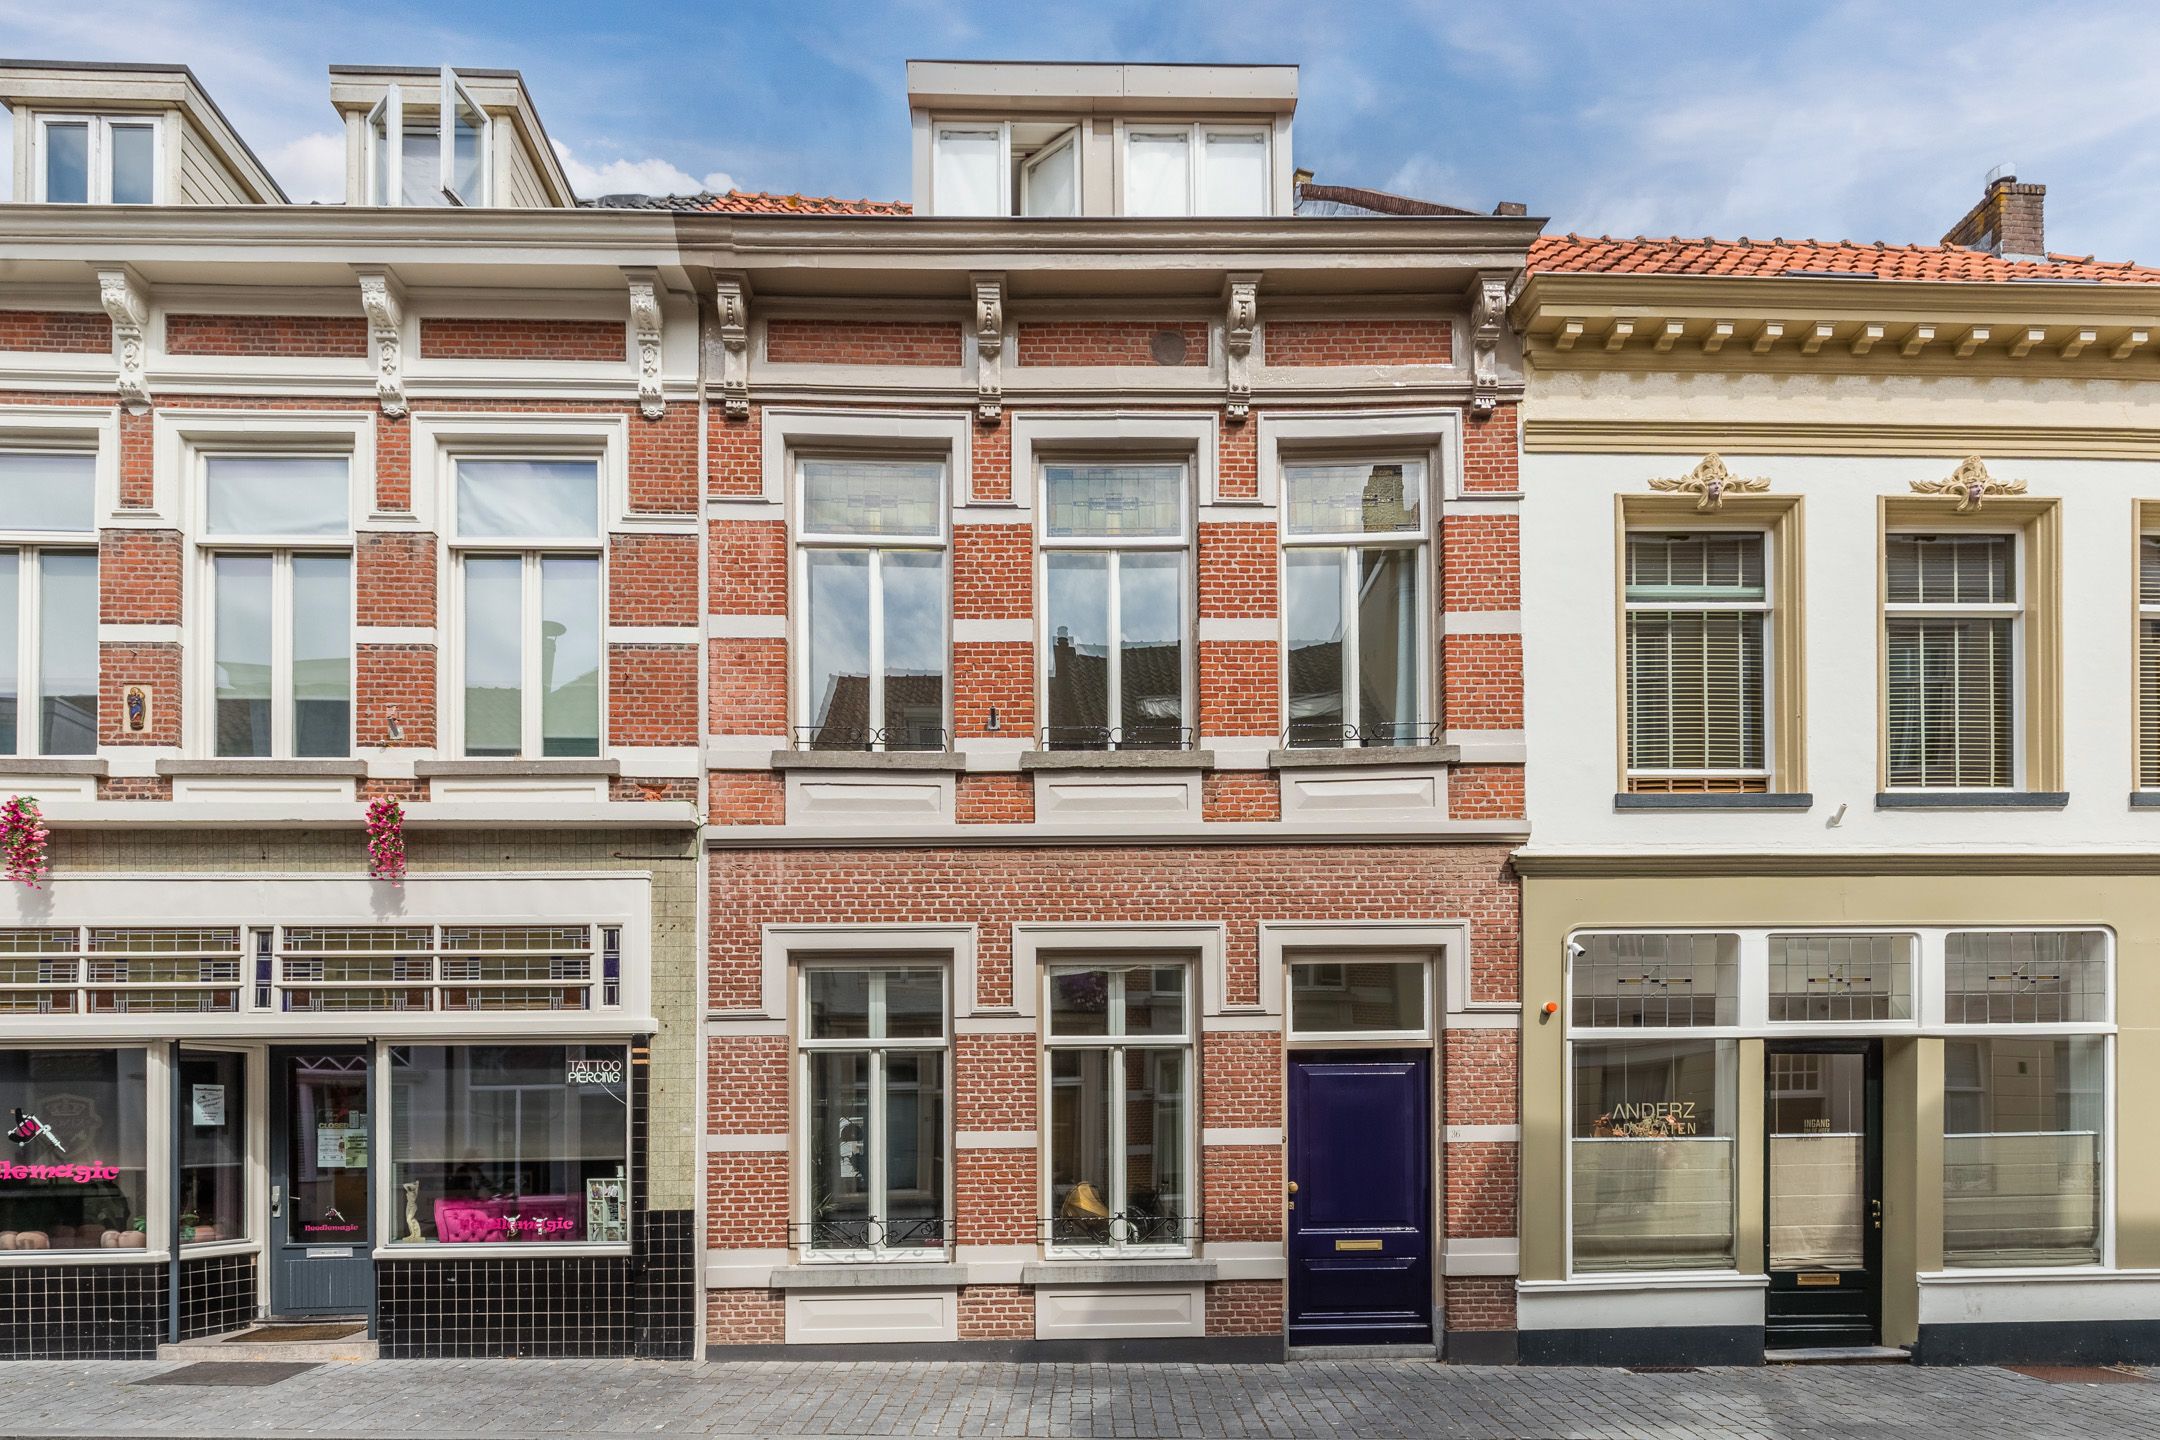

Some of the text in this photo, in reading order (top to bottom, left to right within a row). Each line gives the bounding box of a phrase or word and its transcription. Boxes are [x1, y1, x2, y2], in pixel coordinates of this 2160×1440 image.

[567, 1060, 622, 1072] TATTOO
[567, 1071, 621, 1083] PIERCING
[1612, 1102, 1697, 1119] ANDERZ
[1613, 1121, 1697, 1135] ADCATEN
[1803, 1118, 1831, 1128] INGANG
